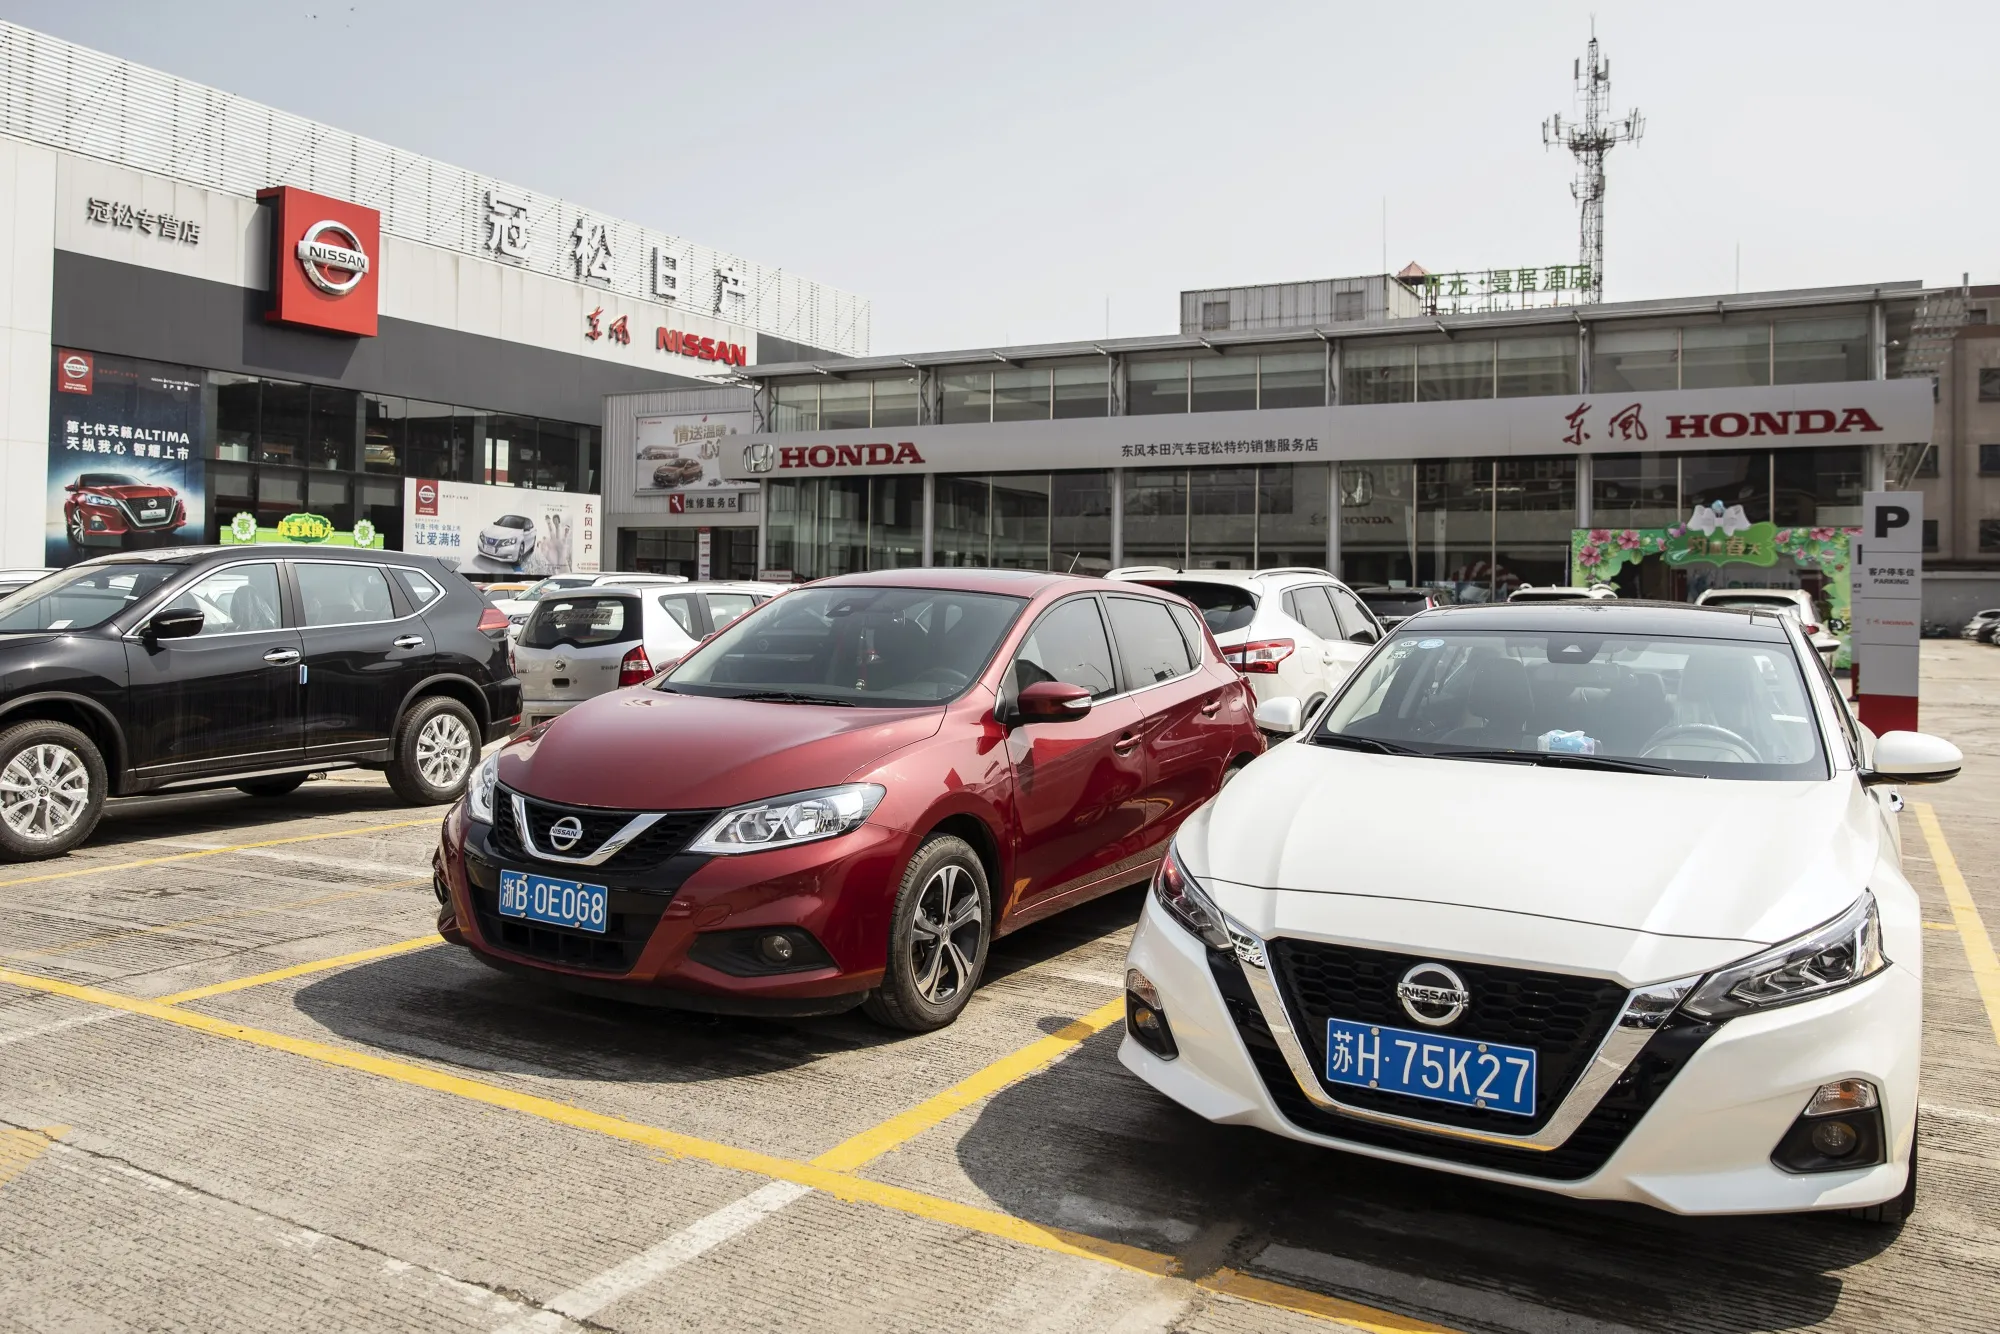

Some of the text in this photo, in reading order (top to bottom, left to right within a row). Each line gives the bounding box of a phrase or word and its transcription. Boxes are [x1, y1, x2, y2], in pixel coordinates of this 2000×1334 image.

[87, 197, 201, 244] 冠松专营店
[308, 245, 367, 269] NISSAN
[585, 306, 747, 368] 东风 NISSAN
[1563, 402, 1883, 446] 东风 HONDA
[66, 436, 126, 455] 天纵我心
[779, 442, 925, 469] HONDA
[1121, 437, 1318, 458] 东风本田汽车冠松特约销售服务店
[686, 496, 737, 509] 维修服务区
[584, 503, 593, 554] 东风日产
[1875, 505, 1910, 538] P
[415, 531, 460, 547] 让爱满格
[1868, 567, 1915, 577] 客户停车位
[1873, 578, 1910, 586] PARKING
[551, 827, 578, 838] NISSAN
[1403, 985, 1462, 1003] NISSAN
[1332, 1029, 1530, 1104] 苏H·75K27
